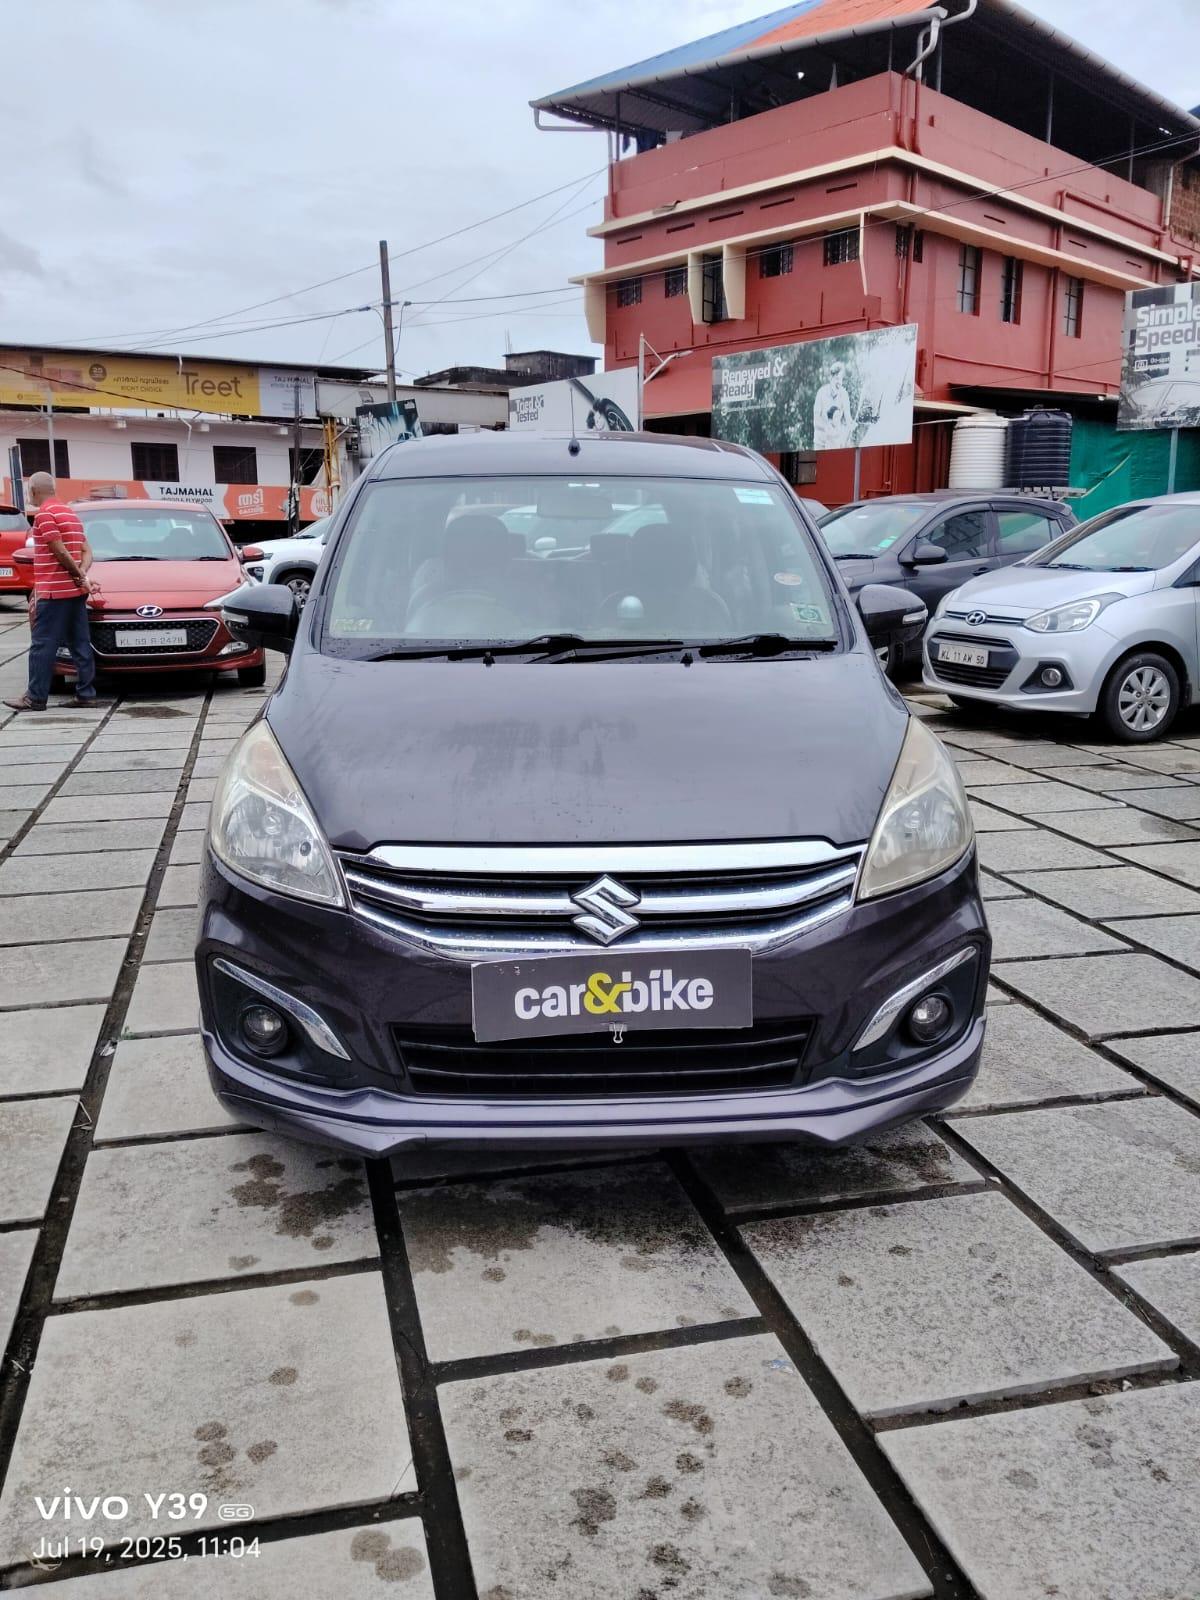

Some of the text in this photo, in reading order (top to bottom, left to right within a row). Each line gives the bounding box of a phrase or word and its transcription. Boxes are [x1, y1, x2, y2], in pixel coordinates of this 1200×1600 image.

[1135, 319, 1200, 352] Speed
[721, 356, 788, 385] Renewed &
[177, 371, 243, 398] Treet
[722, 383, 753, 399] Ready
[517, 408, 539, 422] Tested
[159, 487, 214, 497] TAJMAHAL
[941, 649, 950, 660] KL
[514, 969, 714, 1020] car&bike
